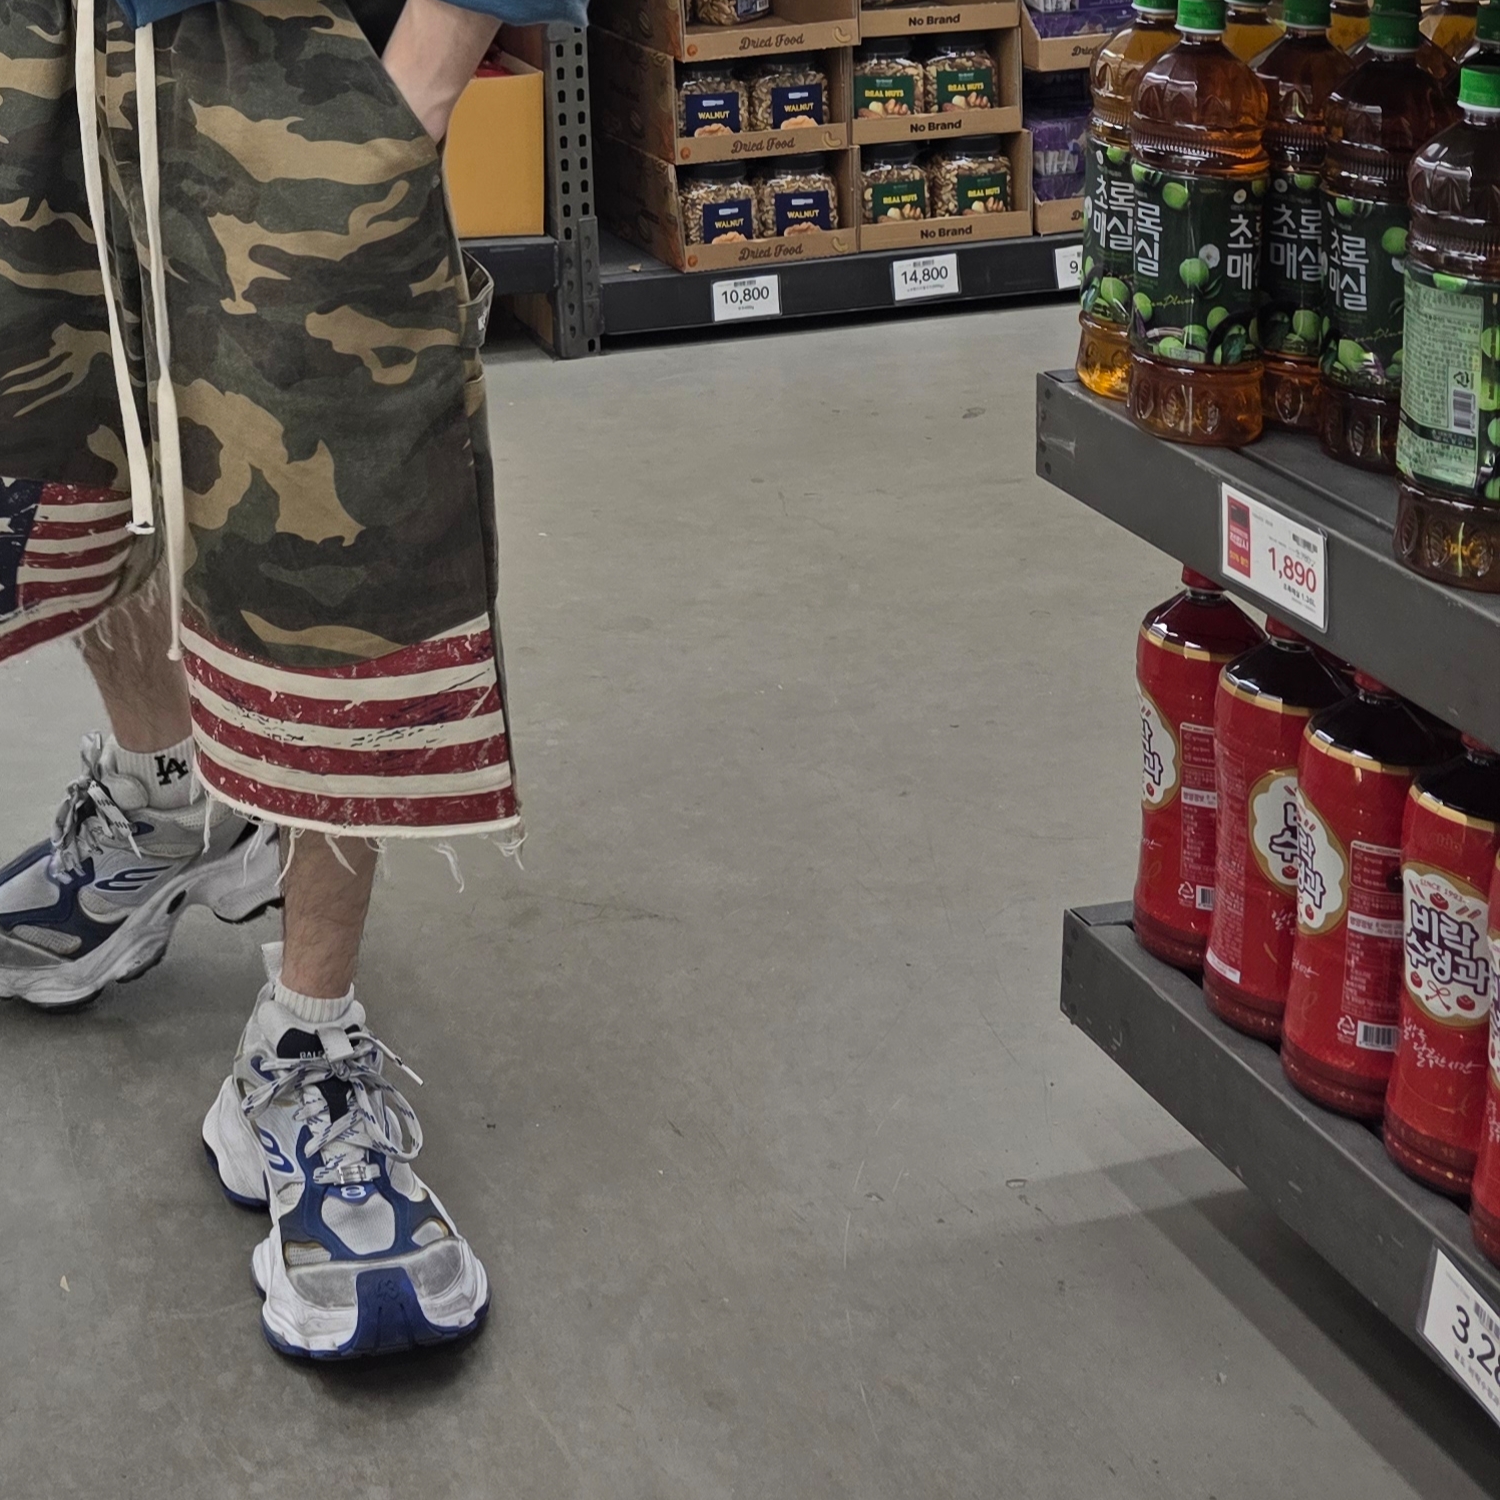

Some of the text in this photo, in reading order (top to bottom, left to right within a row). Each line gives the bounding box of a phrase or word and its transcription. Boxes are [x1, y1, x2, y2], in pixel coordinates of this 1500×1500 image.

[908, 13, 961, 27] No Brand
[739, 33, 805, 51] Dried Food
[697, 110, 730, 120] WALNUT
[784, 102, 815, 112] WALNUT
[909, 119, 962, 134] No Brand
[731, 136, 796, 154] Dried Food
[714, 218, 745, 228] WALNUT
[786, 209, 820, 219] WALNUT
[920, 224, 973, 239] No Brand
[738, 243, 804, 261] Dried Food
[900, 265, 949, 285] 14,800
[721, 285, 770, 305] 10,800
[1268, 546, 1317, 593] 1,890
[154, 754, 189, 787] LA
[1410, 900, 1479, 958] 비락
[1407, 928, 1491, 995] 수정과
